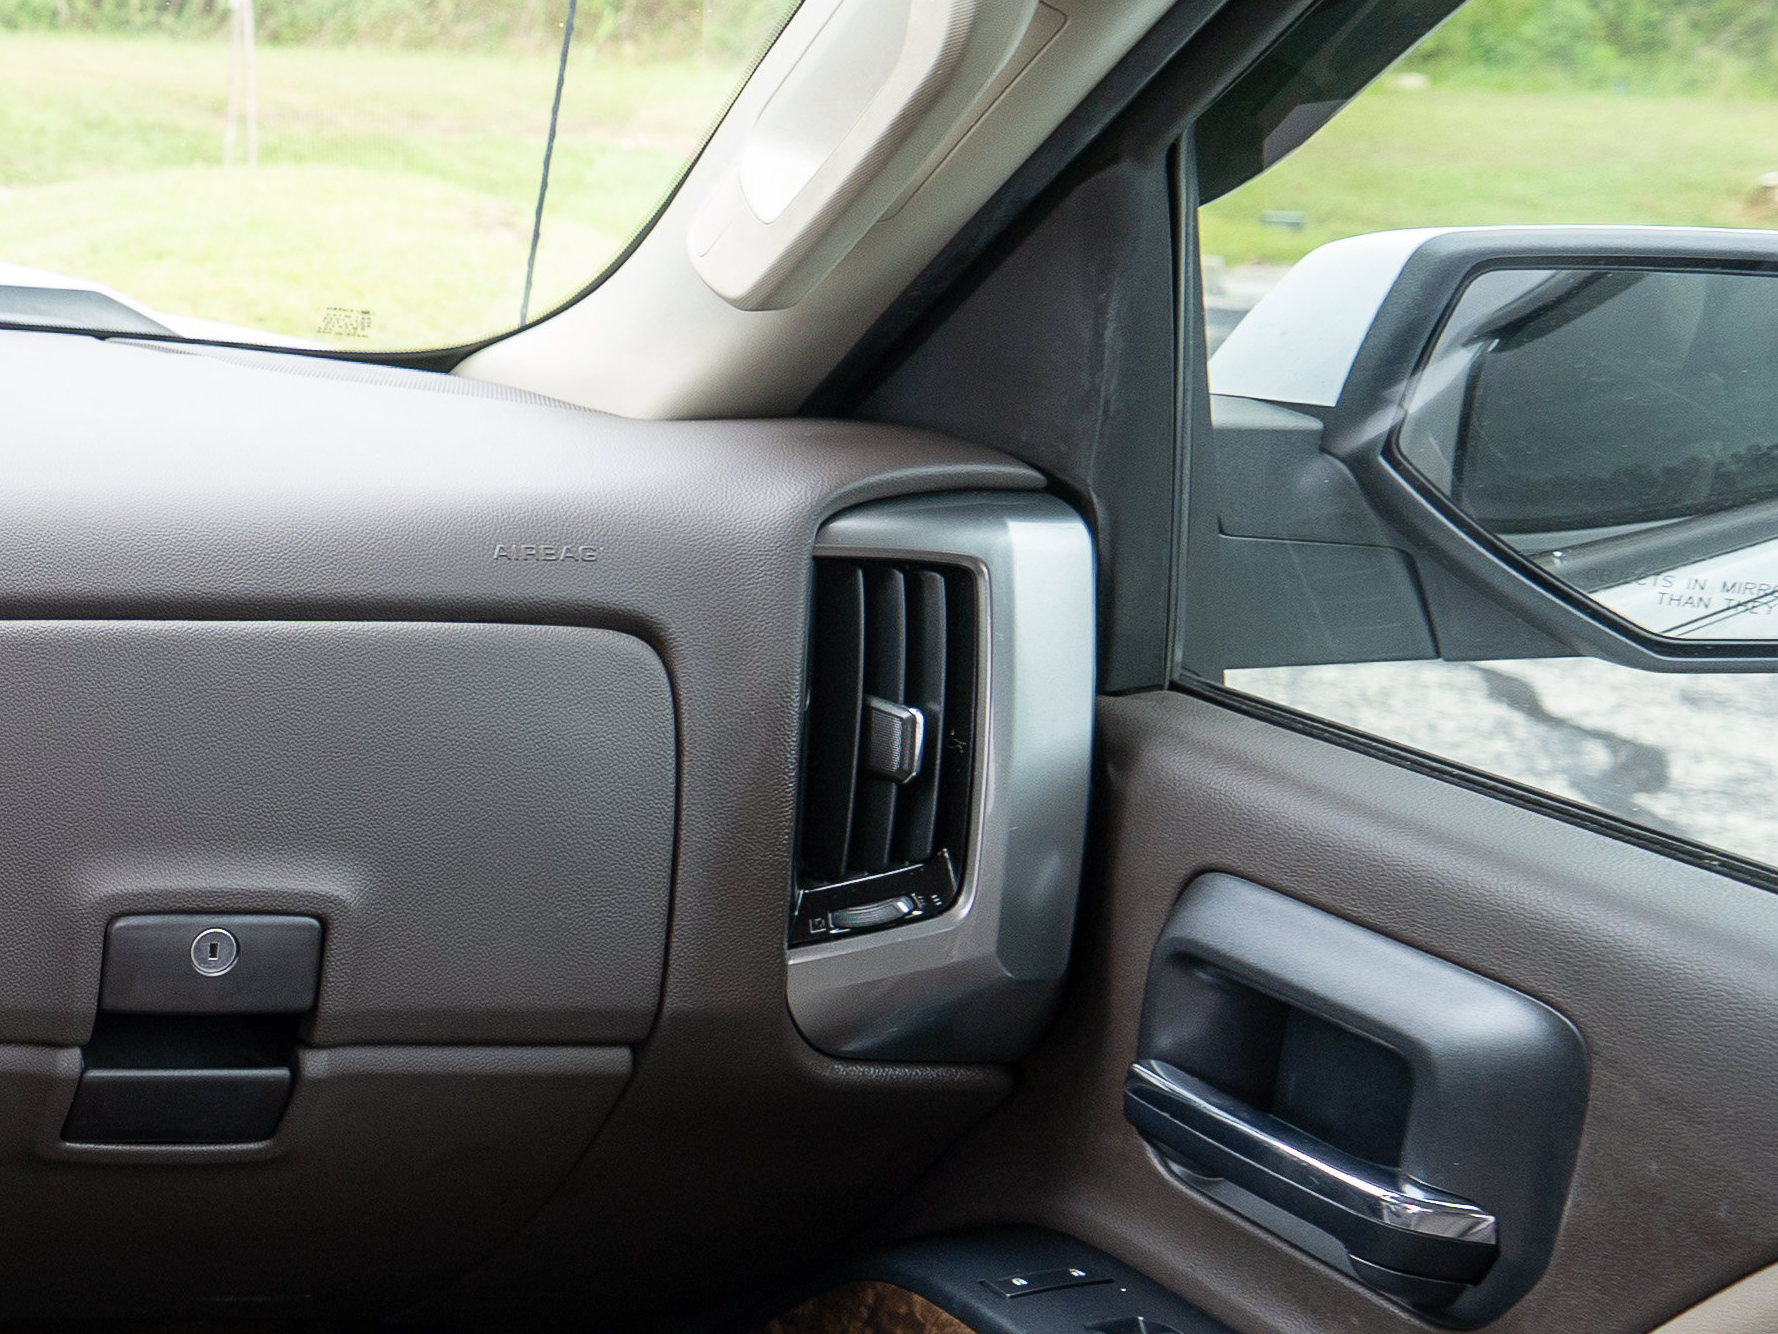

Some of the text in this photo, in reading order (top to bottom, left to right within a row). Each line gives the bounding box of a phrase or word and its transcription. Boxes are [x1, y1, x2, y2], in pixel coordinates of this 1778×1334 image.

[493, 543, 598, 563] AIRBAG
[1686, 578, 1708, 591] IN
[1658, 592, 1711, 609] THAN
